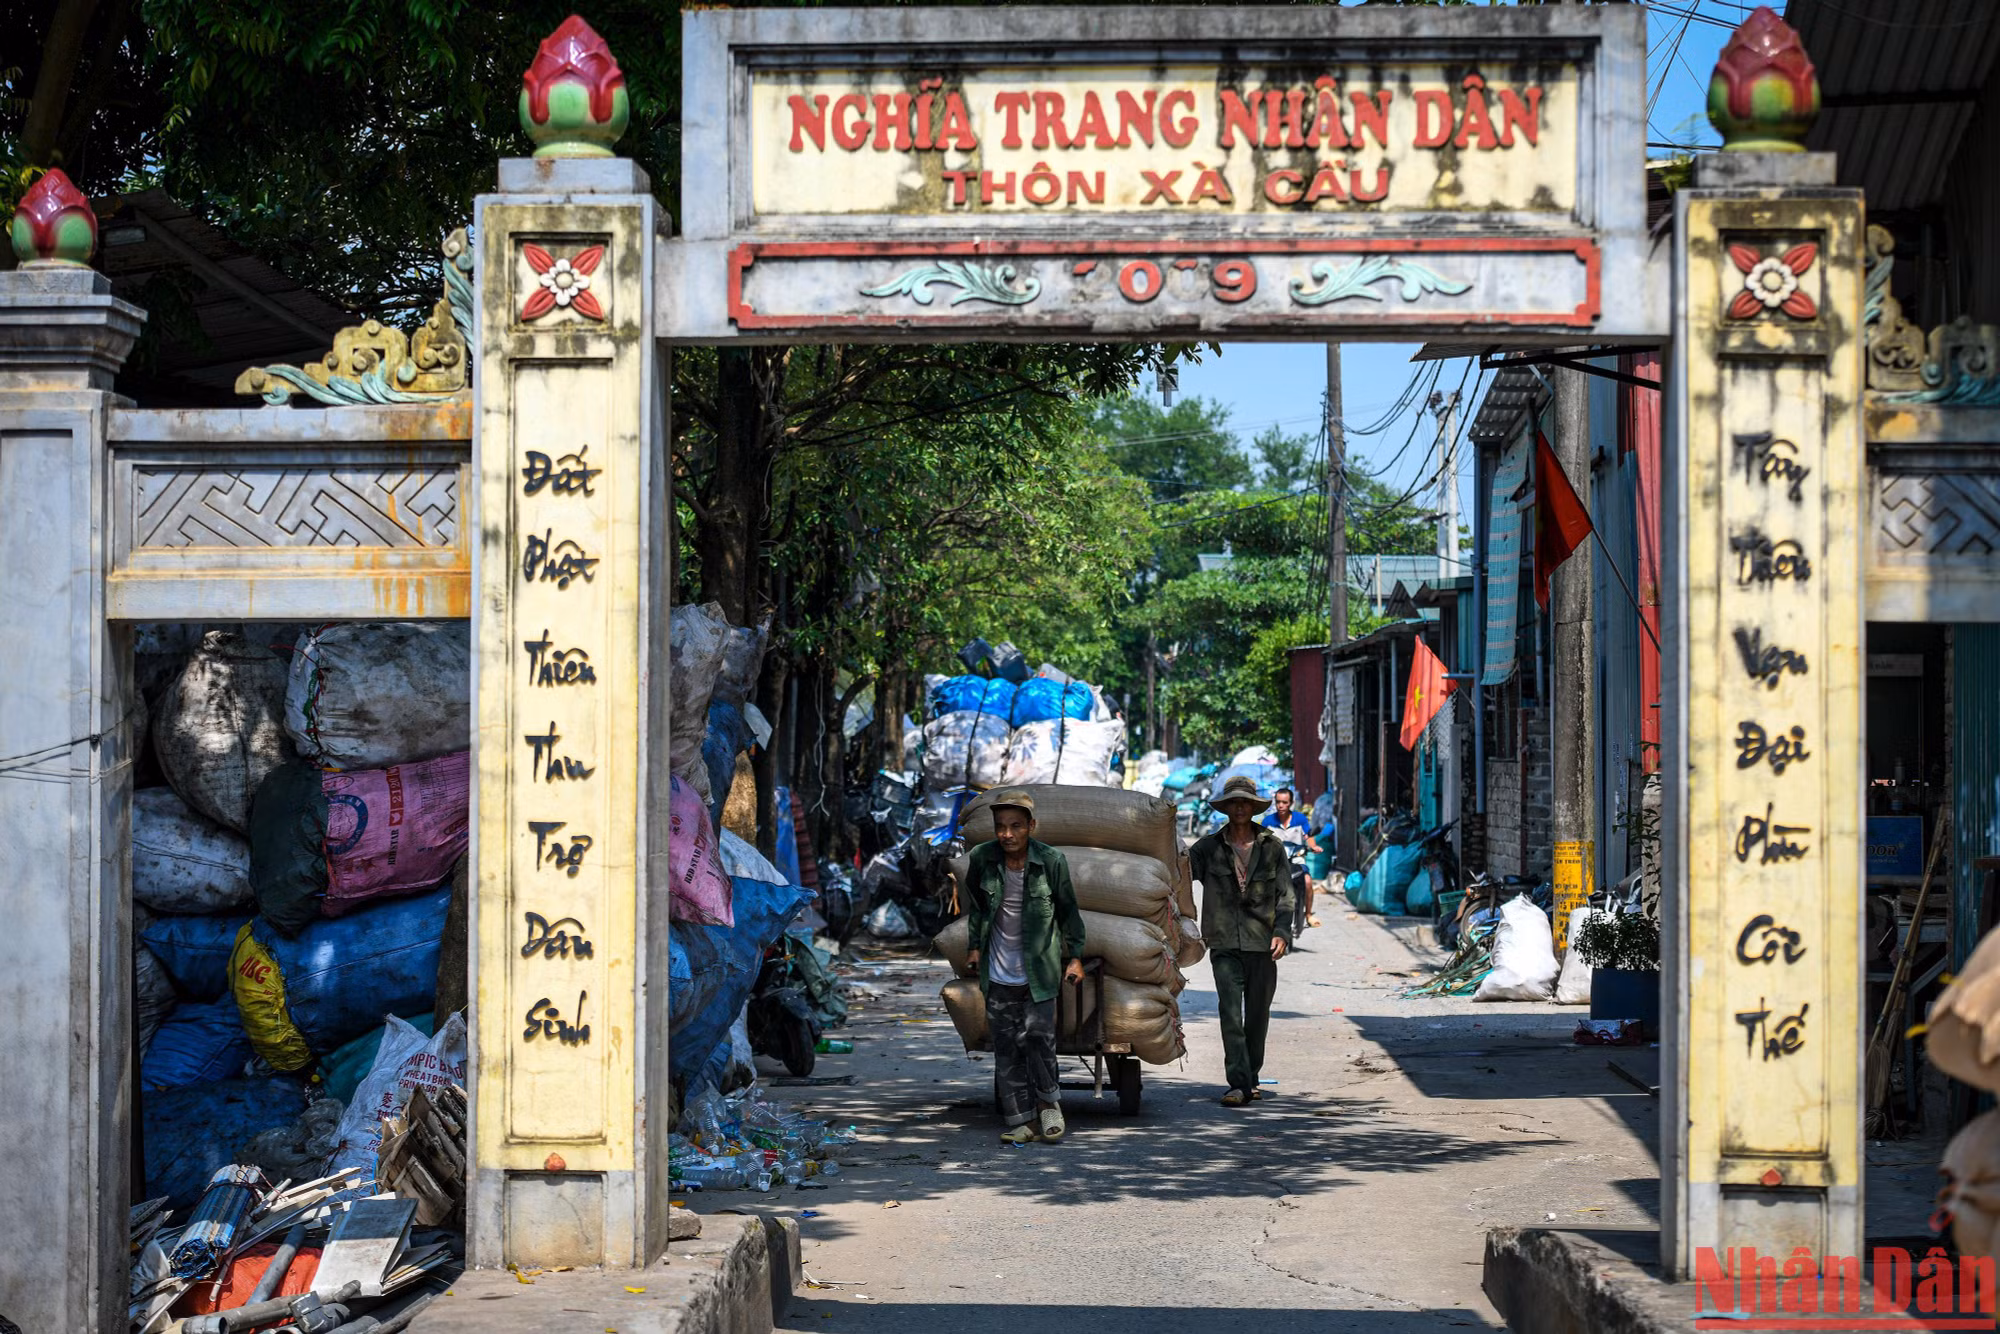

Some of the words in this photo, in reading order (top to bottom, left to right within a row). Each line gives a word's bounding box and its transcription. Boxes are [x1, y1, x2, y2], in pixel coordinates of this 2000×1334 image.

[788, 77, 977, 152] NGHĨA
[994, 90, 1199, 150] TRANG
[1220, 74, 1393, 149] NHÂN
[1412, 73, 1542, 149] DÂN
[942, 161, 1105, 205] THÔN
[1140, 161, 1233, 205] XÀ
[522, 444, 602, 496] Đất
[1732, 431, 1811, 503] Tây
[523, 527, 599, 591] Phật
[524, 628, 597, 688] Thiên
[1732, 626, 1808, 691] Vạn
[524, 721, 595, 784] Thu
[1735, 720, 1810, 776] Đại
[390, 829, 398, 848] STAR
[528, 821, 592, 879] Trợ
[521, 911, 593, 960] Dân
[523, 990, 590, 1047] Sinh
[1735, 996, 1809, 1062] Thế
